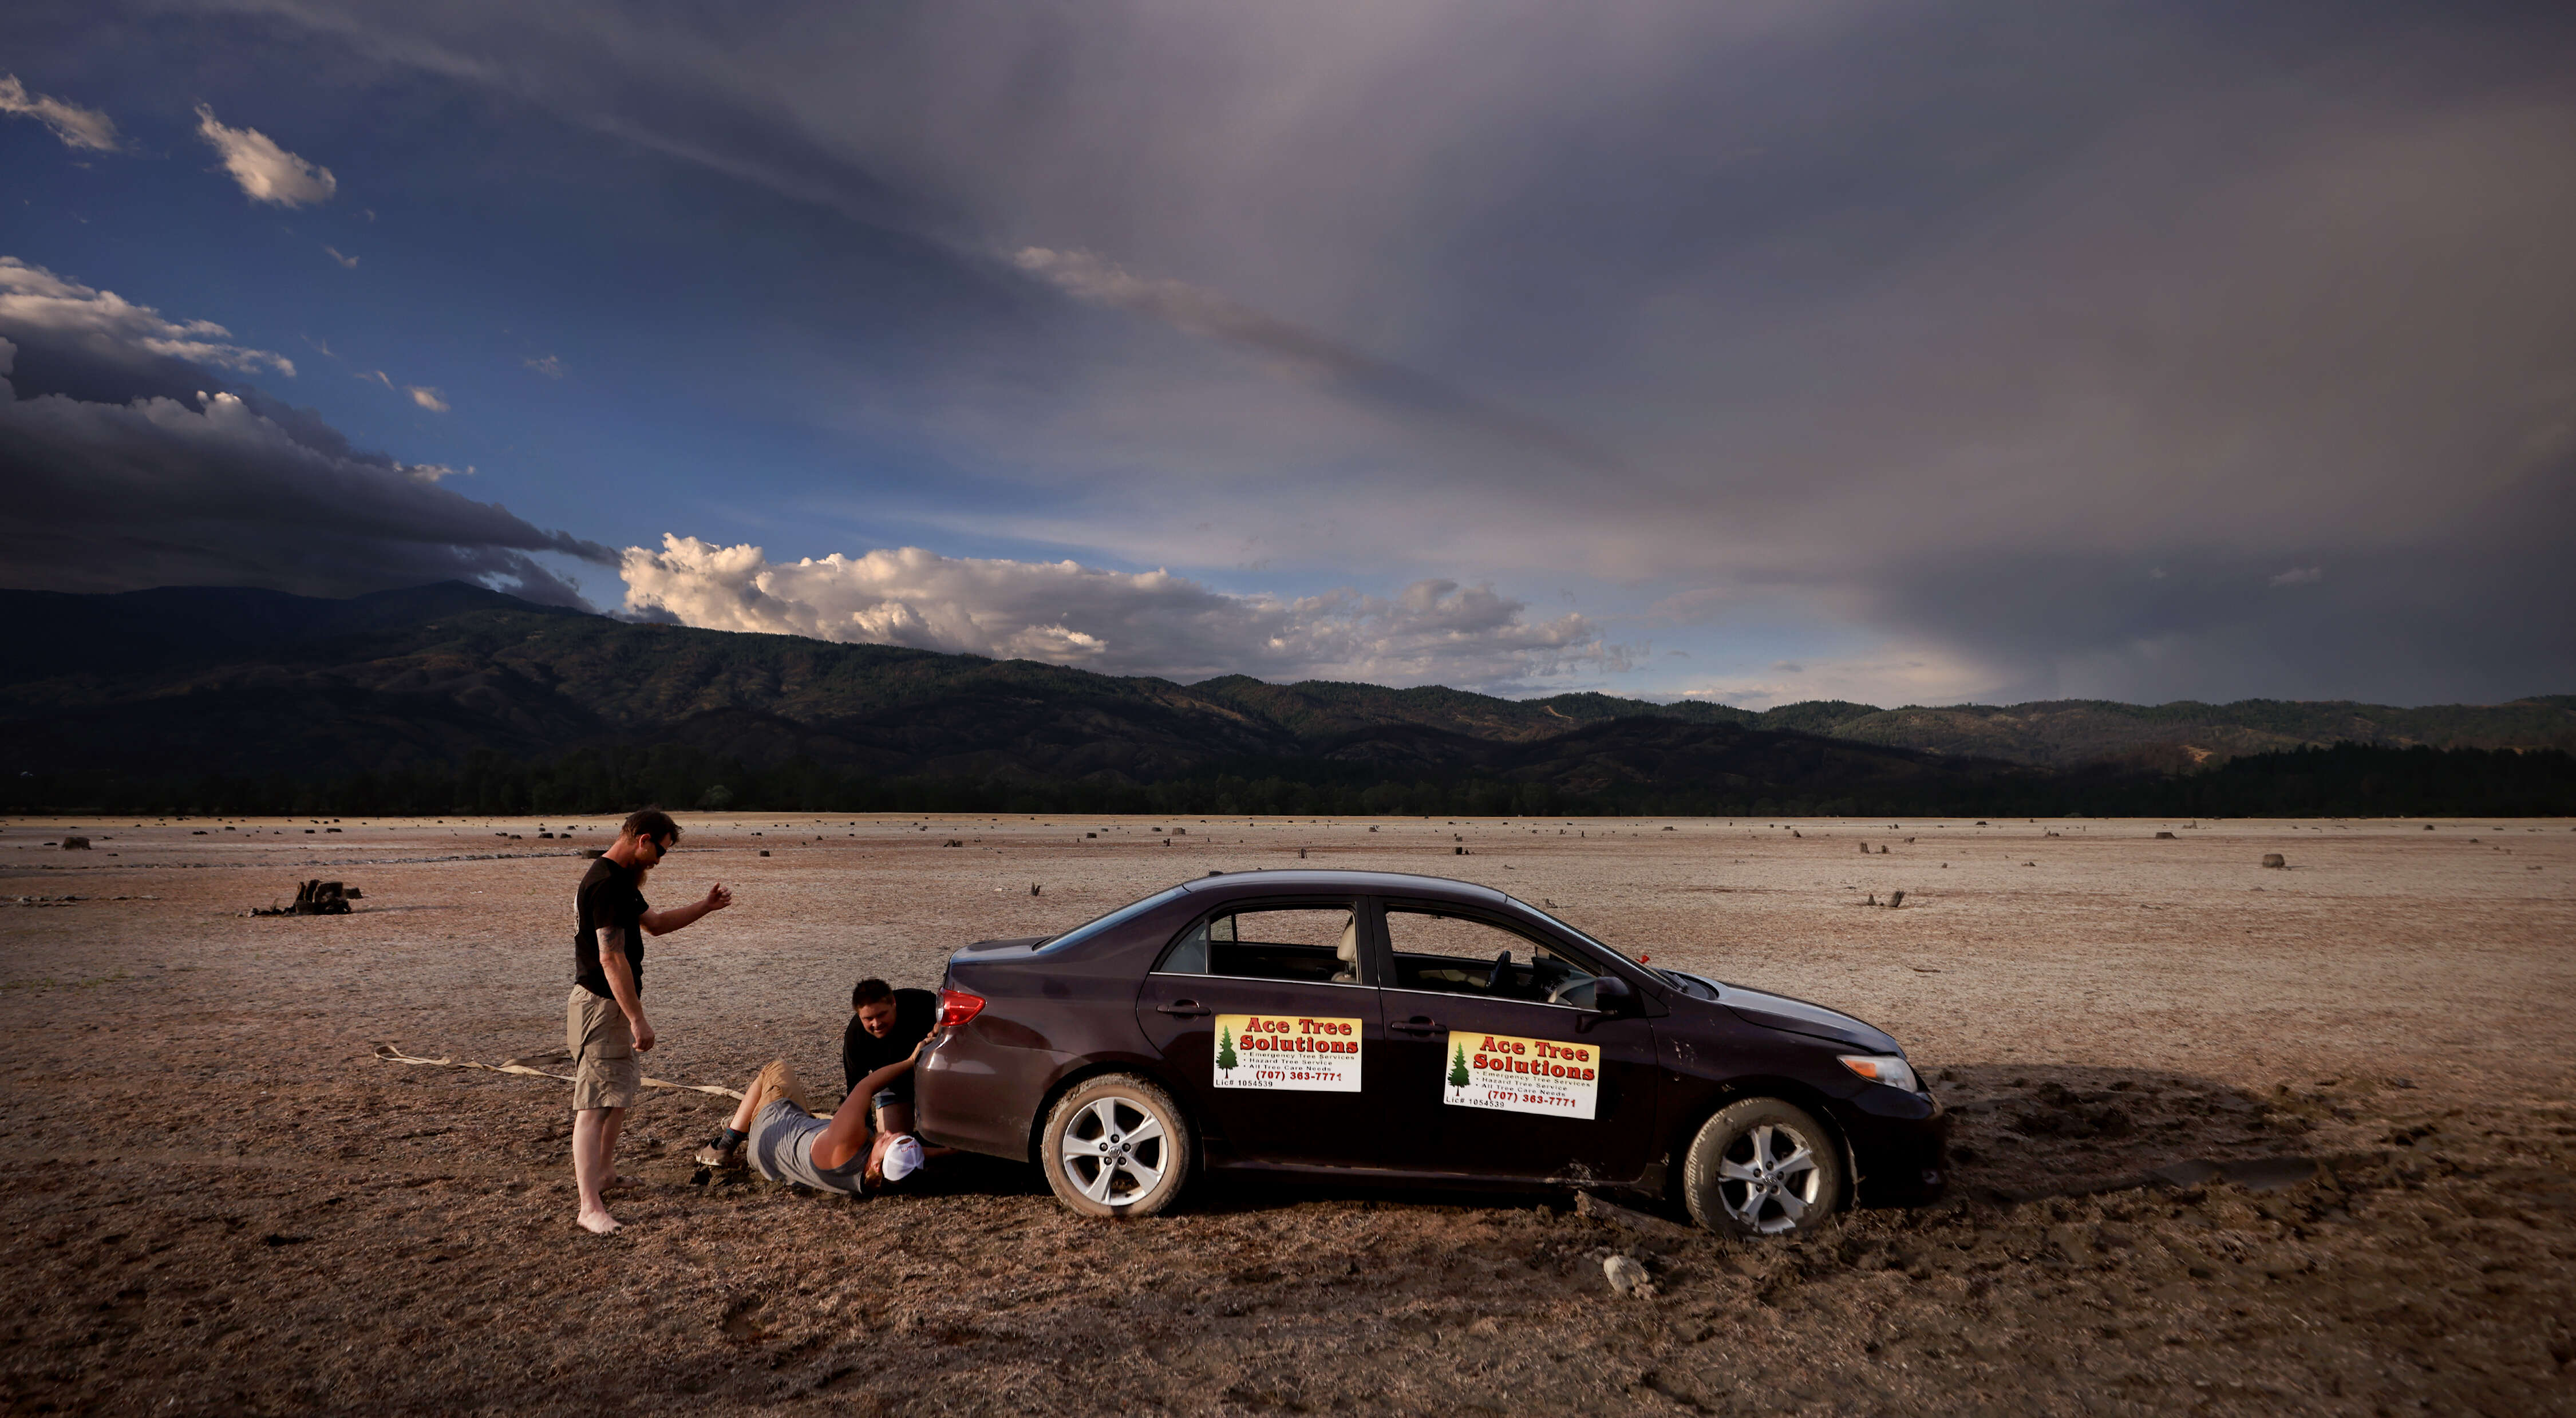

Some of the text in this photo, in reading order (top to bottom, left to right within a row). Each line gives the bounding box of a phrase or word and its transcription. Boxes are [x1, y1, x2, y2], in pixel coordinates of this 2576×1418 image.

[1246, 1017, 1352, 1035] Ace Tree
[1240, 1035, 1358, 1053] Solutions
[1480, 1036, 1589, 1062] Ace Tree
[1256, 1071, 1341, 1081] (707) 363-7771
[1473, 1054, 1595, 1081] Solutions
[1483, 1071, 1529, 1081] Emergency
[1554, 1079, 1590, 1087] Services
[1536, 1083, 1567, 1091] Service
[1469, 1099, 1504, 1108] 1054539
[1488, 1090, 1575, 1107] (707) 363-7771
